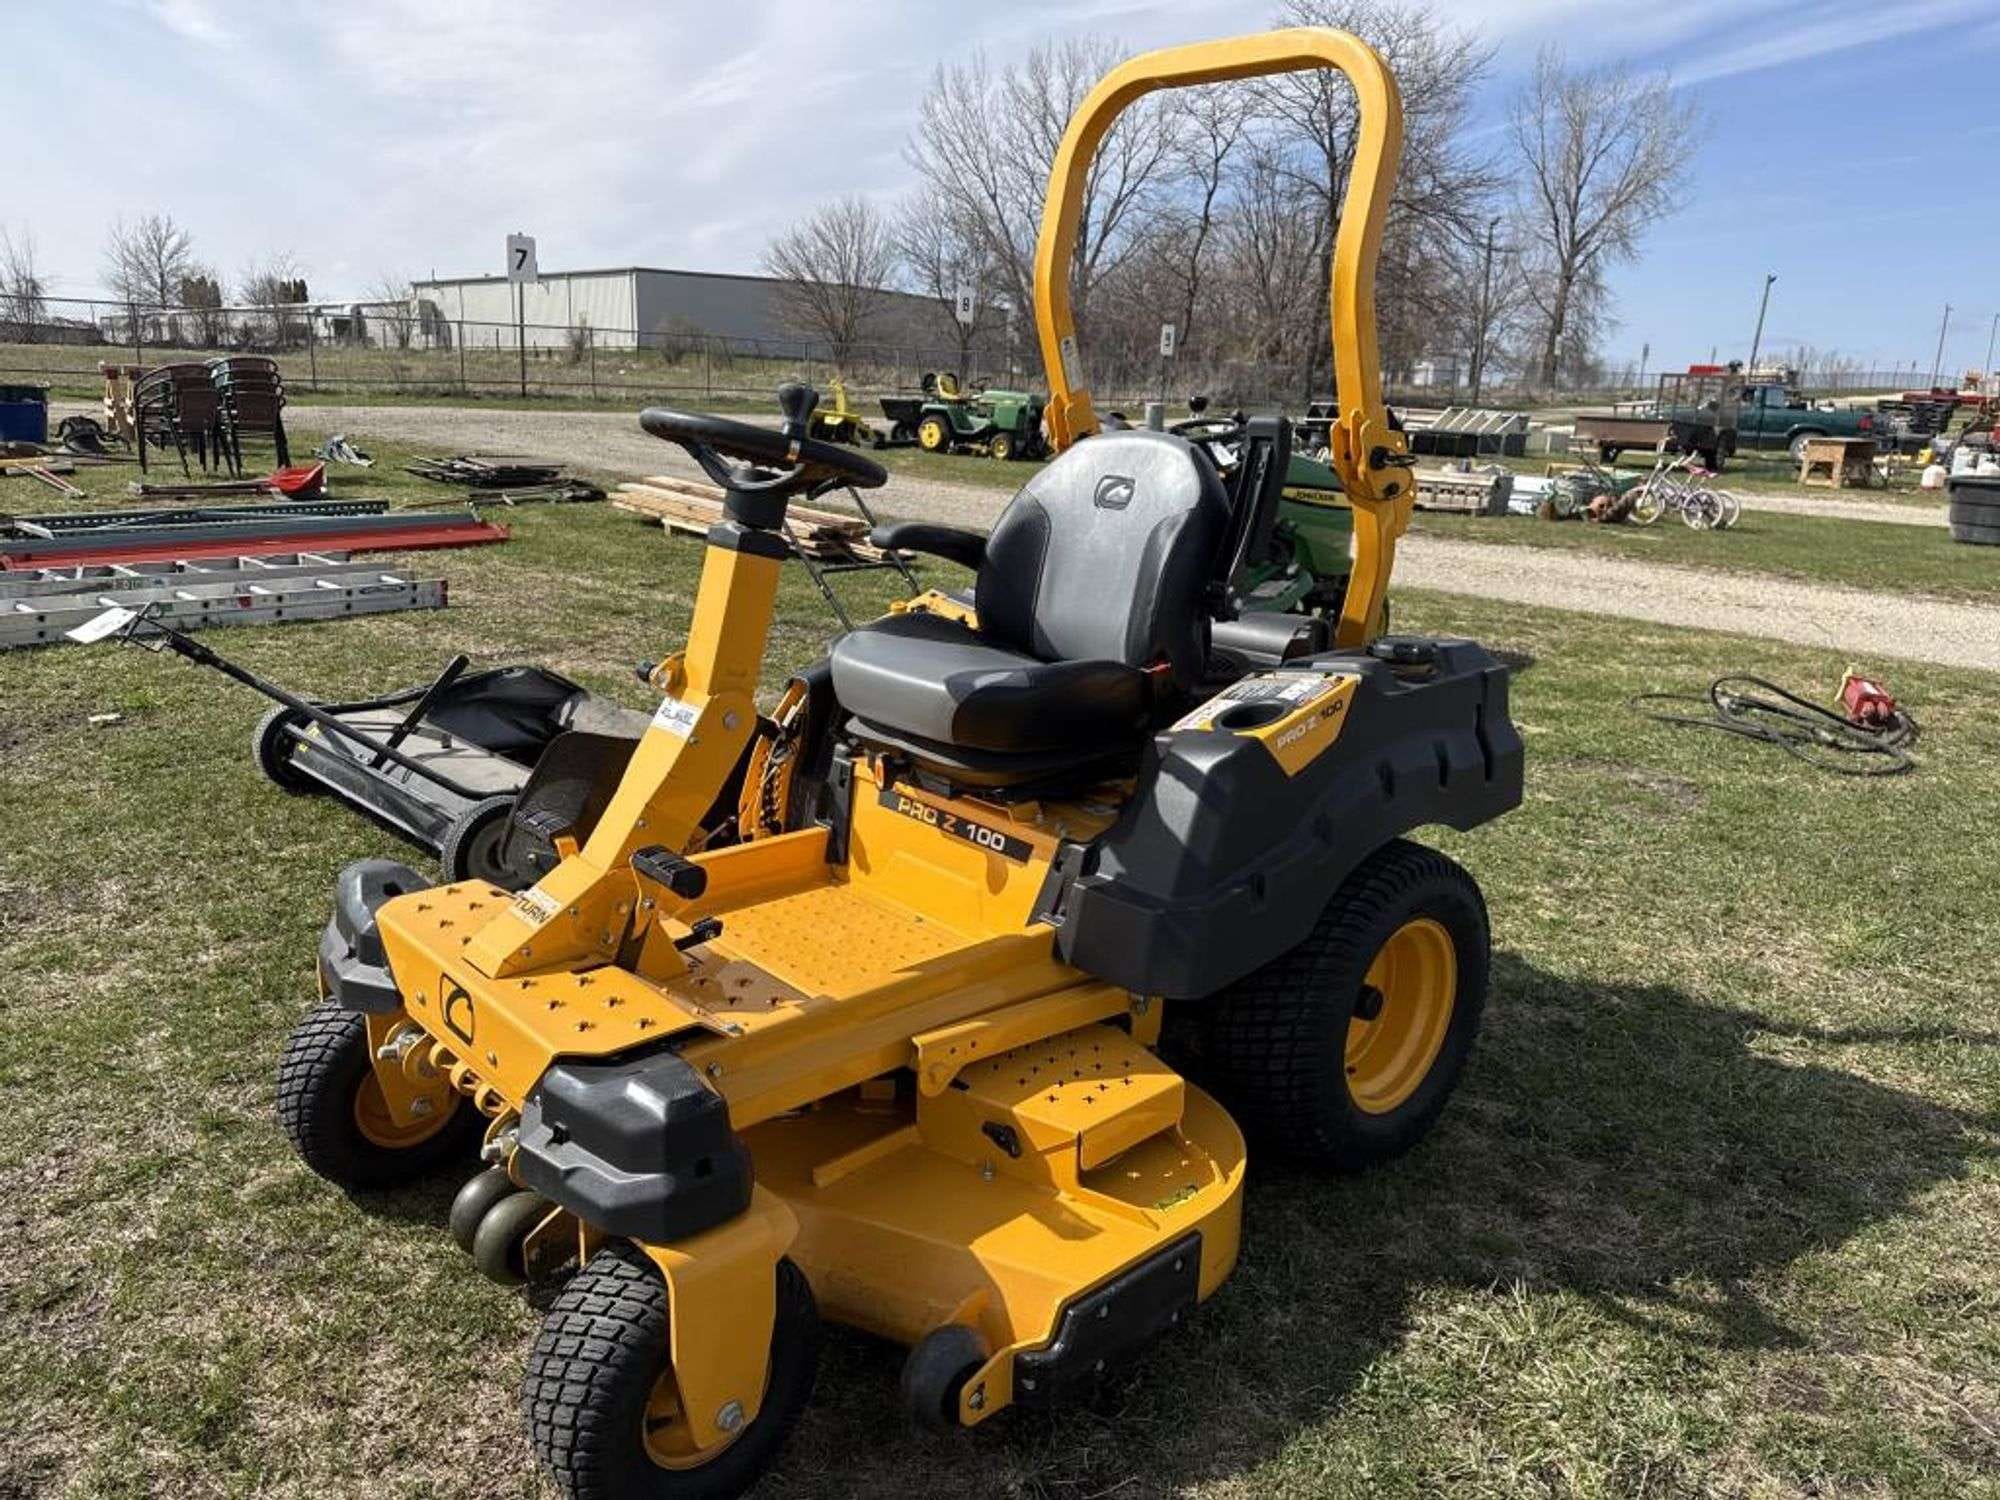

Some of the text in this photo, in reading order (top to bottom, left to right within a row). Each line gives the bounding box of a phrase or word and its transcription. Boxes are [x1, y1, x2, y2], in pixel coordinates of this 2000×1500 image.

[515, 248, 527, 270] 7
[963, 297, 970, 311] 8
[1277, 699, 1343, 748] PRO Z 100
[898, 797, 1006, 851] PRO Z 100
